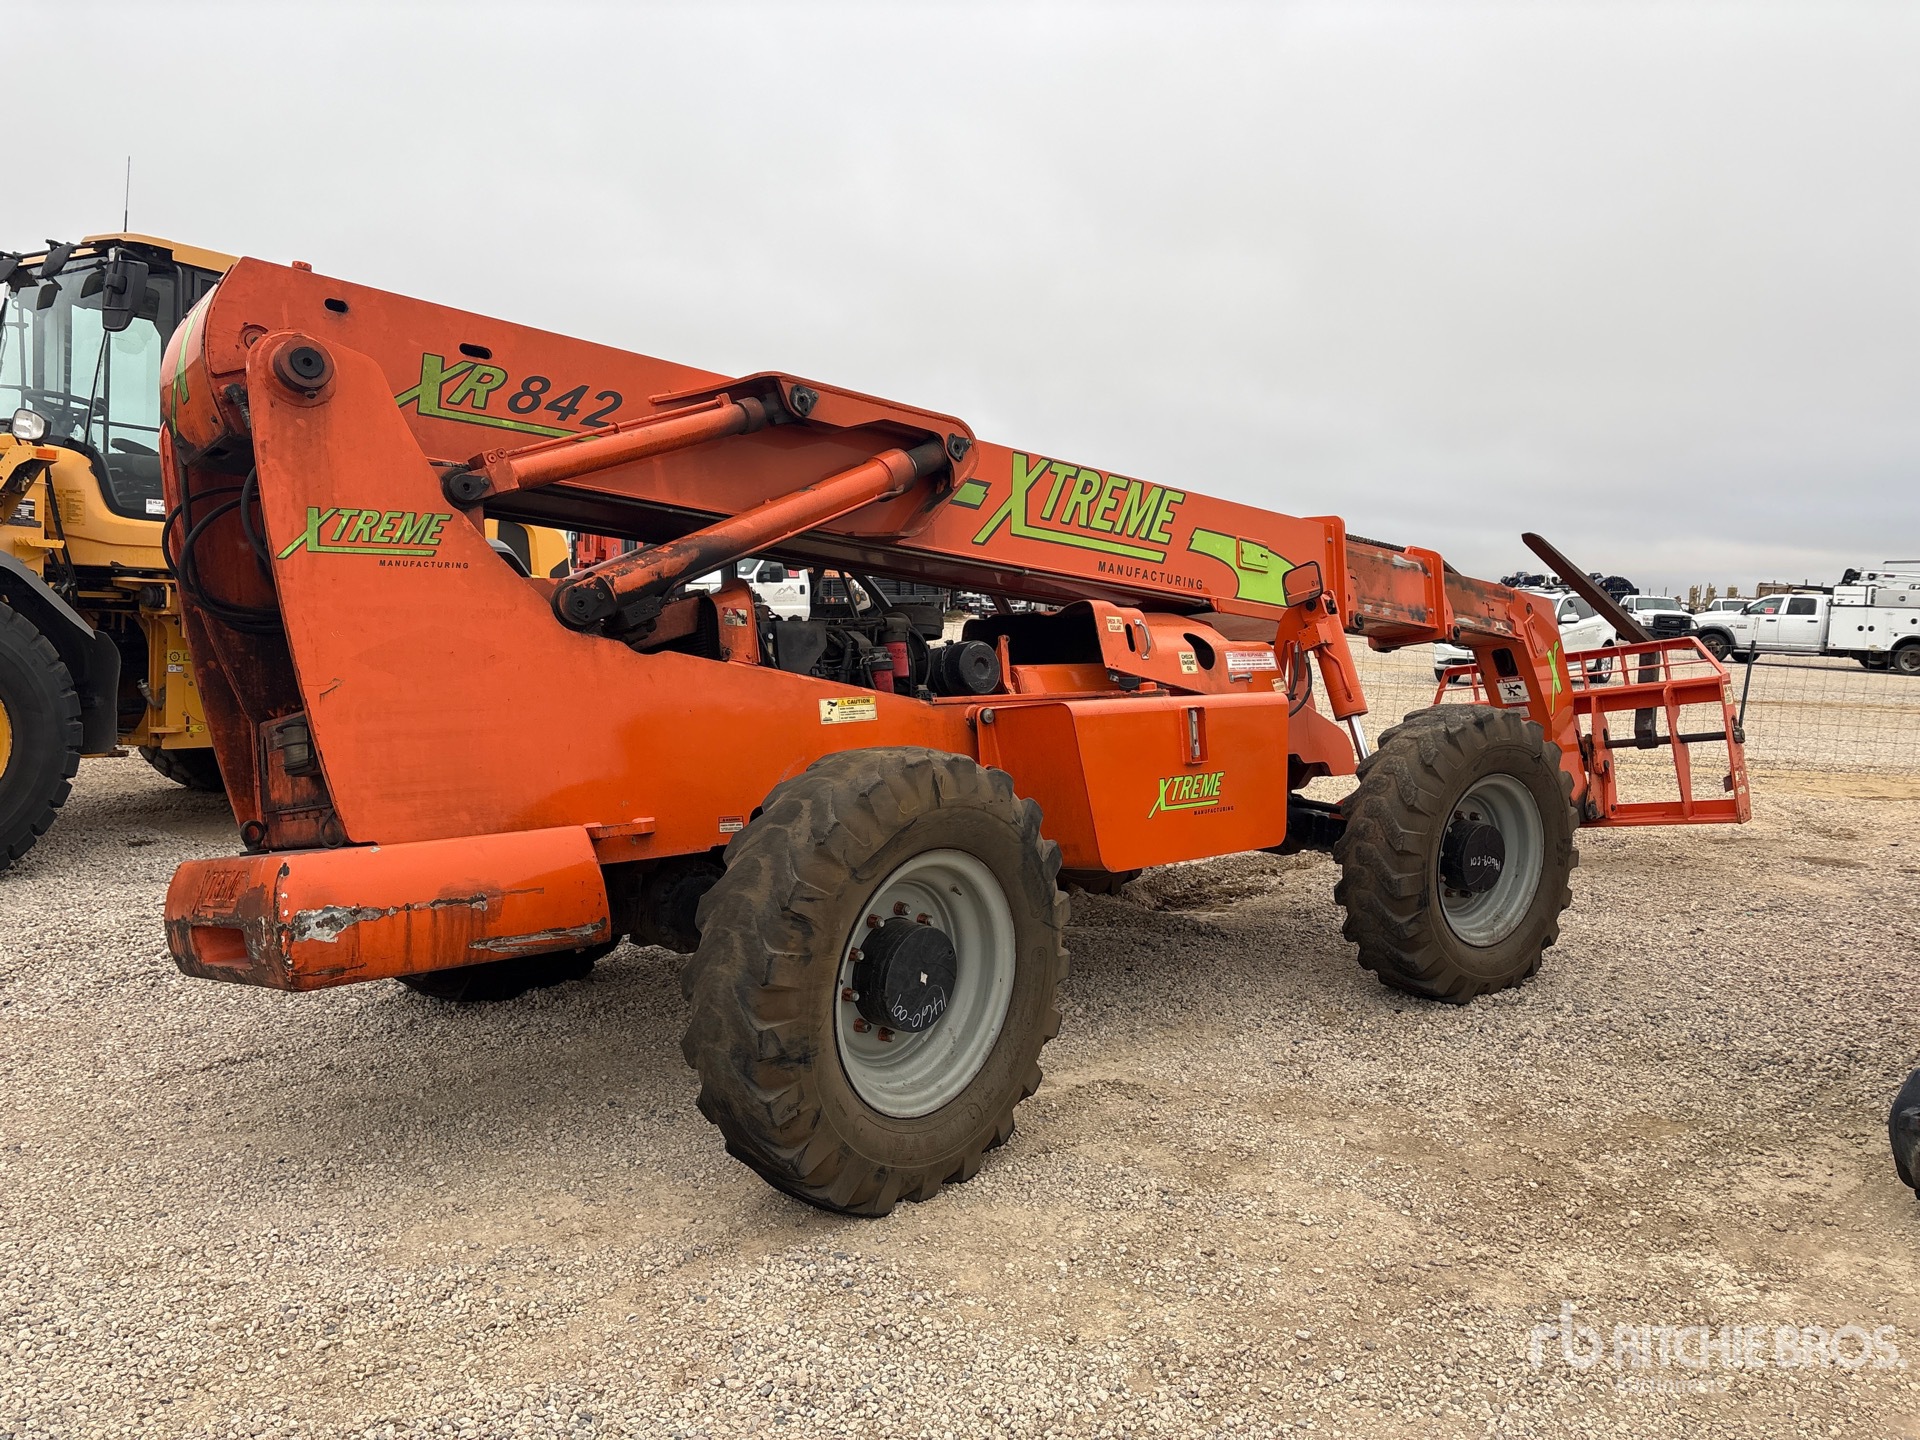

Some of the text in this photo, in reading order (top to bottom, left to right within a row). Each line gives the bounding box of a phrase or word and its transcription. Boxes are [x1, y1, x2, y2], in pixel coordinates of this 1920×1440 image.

[395, 353, 623, 427] XR 842
[972, 451, 1186, 556] XTREME
[276, 506, 452, 560] XTREME
[379, 559, 469, 569] MANUFACTURING
[1098, 561, 1203, 590] MANUFACTURING
[1148, 771, 1225, 818] XTREME
[1193, 805, 1235, 816] MANUFACTURING
